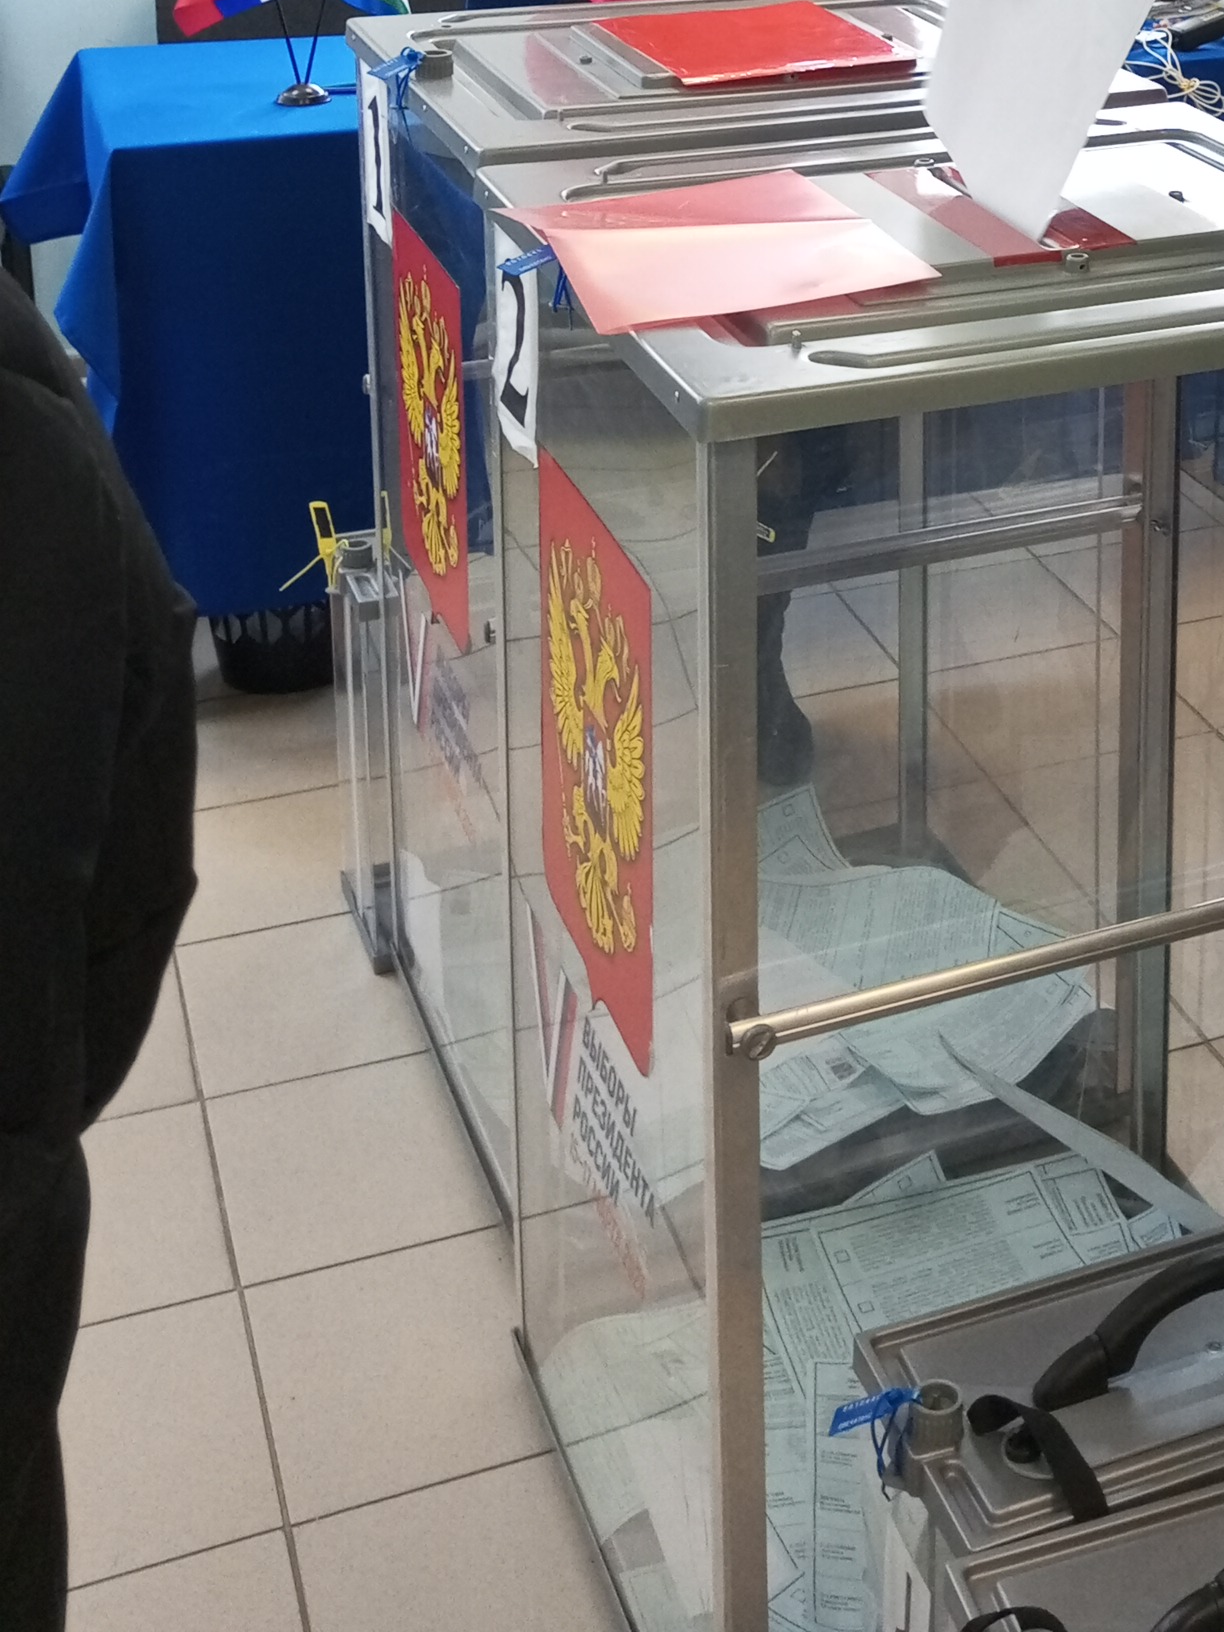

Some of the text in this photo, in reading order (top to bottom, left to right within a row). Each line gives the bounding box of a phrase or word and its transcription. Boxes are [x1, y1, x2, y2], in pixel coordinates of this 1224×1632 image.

[367, 95, 386, 221] 1
[500, 268, 530, 428] 2
[582, 1016, 637, 1137] ВЫБОРЫ
[573, 1095, 620, 1207] РОССИИ
[577, 1056, 656, 1230] ПРЕЗИДЕНТА
